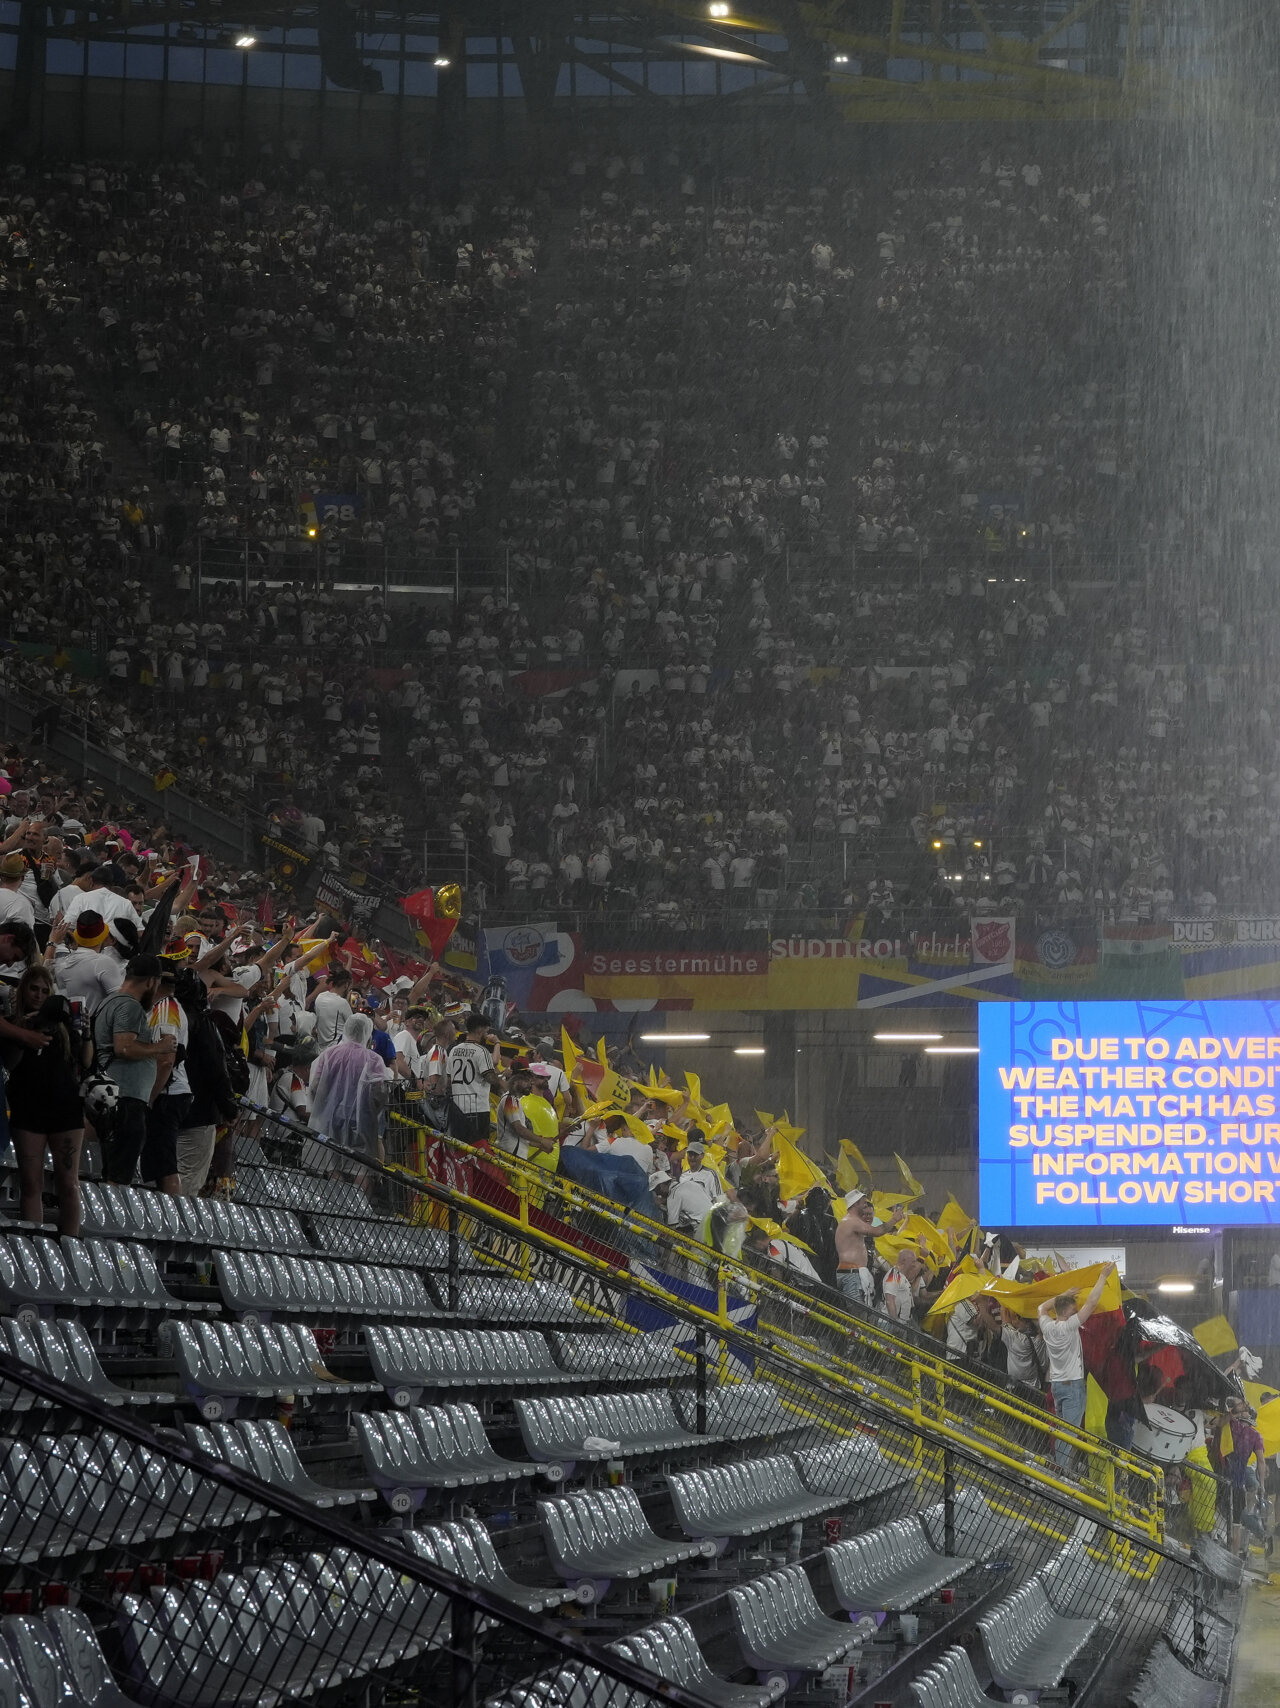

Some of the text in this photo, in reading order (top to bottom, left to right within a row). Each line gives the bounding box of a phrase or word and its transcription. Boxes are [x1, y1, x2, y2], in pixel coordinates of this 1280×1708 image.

[1173, 921, 1215, 942] DUIS
[771, 934, 907, 959] SÜDTIROL
[592, 955, 759, 973] Seestermühe
[1051, 1039, 1120, 1060] DUE
[1124, 1038, 1170, 1059] TO
[452, 1058, 476, 1085] 20
[998, 1067, 1167, 1089] WEATHER
[1013, 1095, 1079, 1117] THE
[1085, 1095, 1202, 1117] MATCH
[1209, 1095, 1275, 1116] HAS
[1008, 1124, 1214, 1147] SUSPENDED.
[1033, 1152, 1262, 1176] INFORMATION
[1036, 1181, 1179, 1204] FOLLOW
[1172, 1225, 1210, 1235] Hisense
